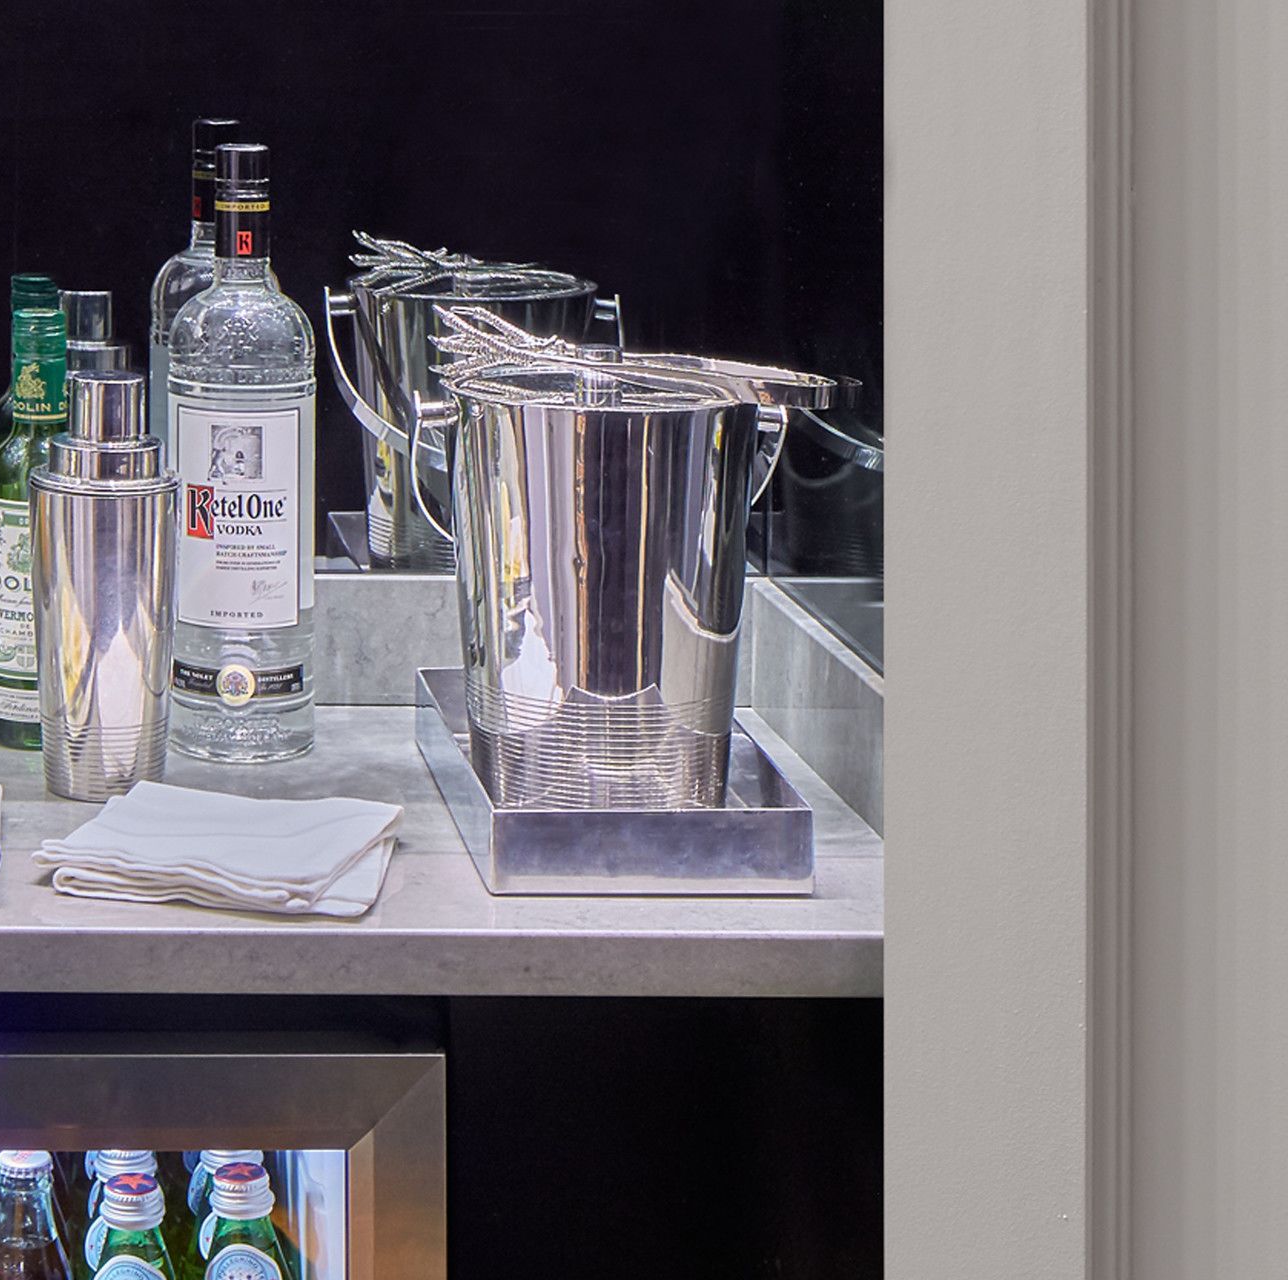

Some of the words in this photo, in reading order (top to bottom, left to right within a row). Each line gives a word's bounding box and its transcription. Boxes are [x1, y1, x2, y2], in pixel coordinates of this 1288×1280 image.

[238, 234, 250, 252] K
[188, 488, 244, 535] Ketel
[246, 494, 284, 519] One
[216, 524, 263, 536] VODKA
[0, 608, 34, 622] VERMO
[210, 610, 264, 618] IMPORTED
[0, 627, 33, 637] CHAMB
